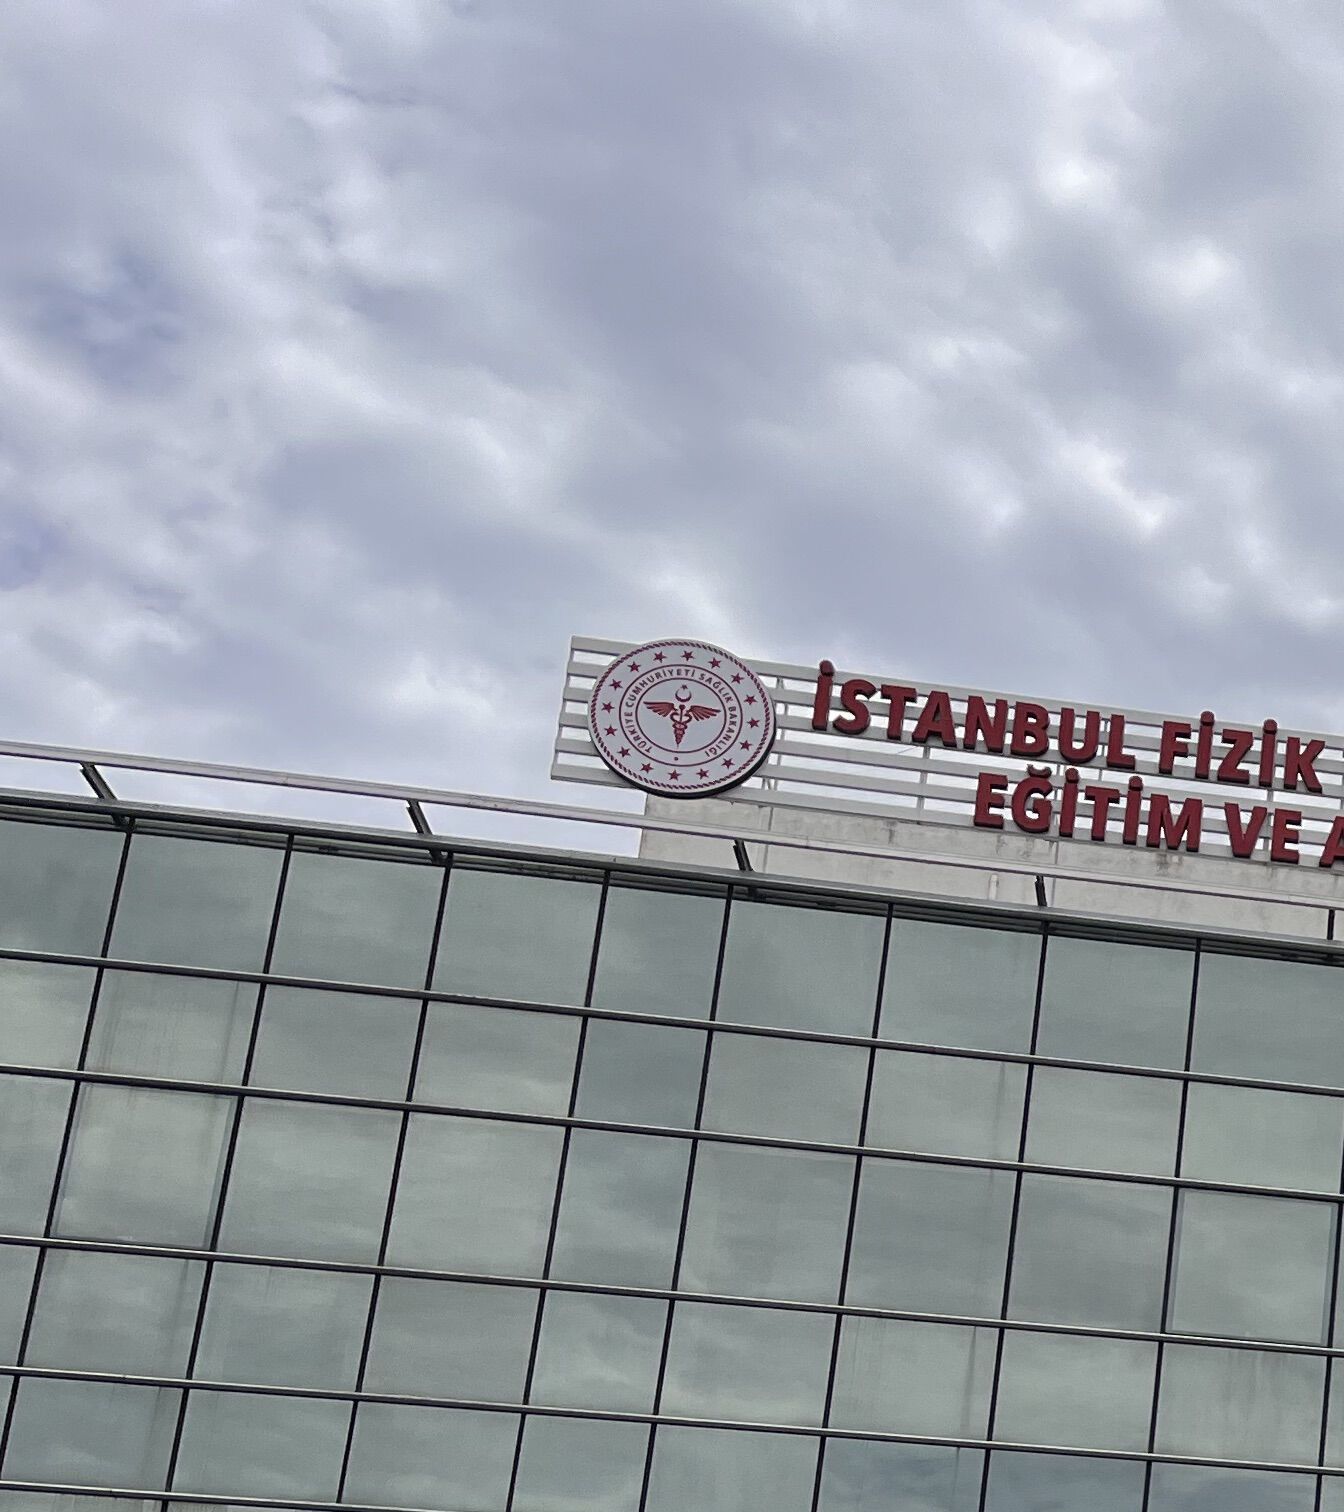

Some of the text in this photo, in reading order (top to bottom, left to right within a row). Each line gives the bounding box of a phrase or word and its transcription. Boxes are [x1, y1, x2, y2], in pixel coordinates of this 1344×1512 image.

[627, 668, 696, 708] CUMHURİYETİ
[811, 660, 1136, 771] İSTANBUL
[1158, 711, 1325, 793] FİZİK
[973, 764, 1204, 853] EĞİTİM
[1224, 802, 1303, 864] VE
